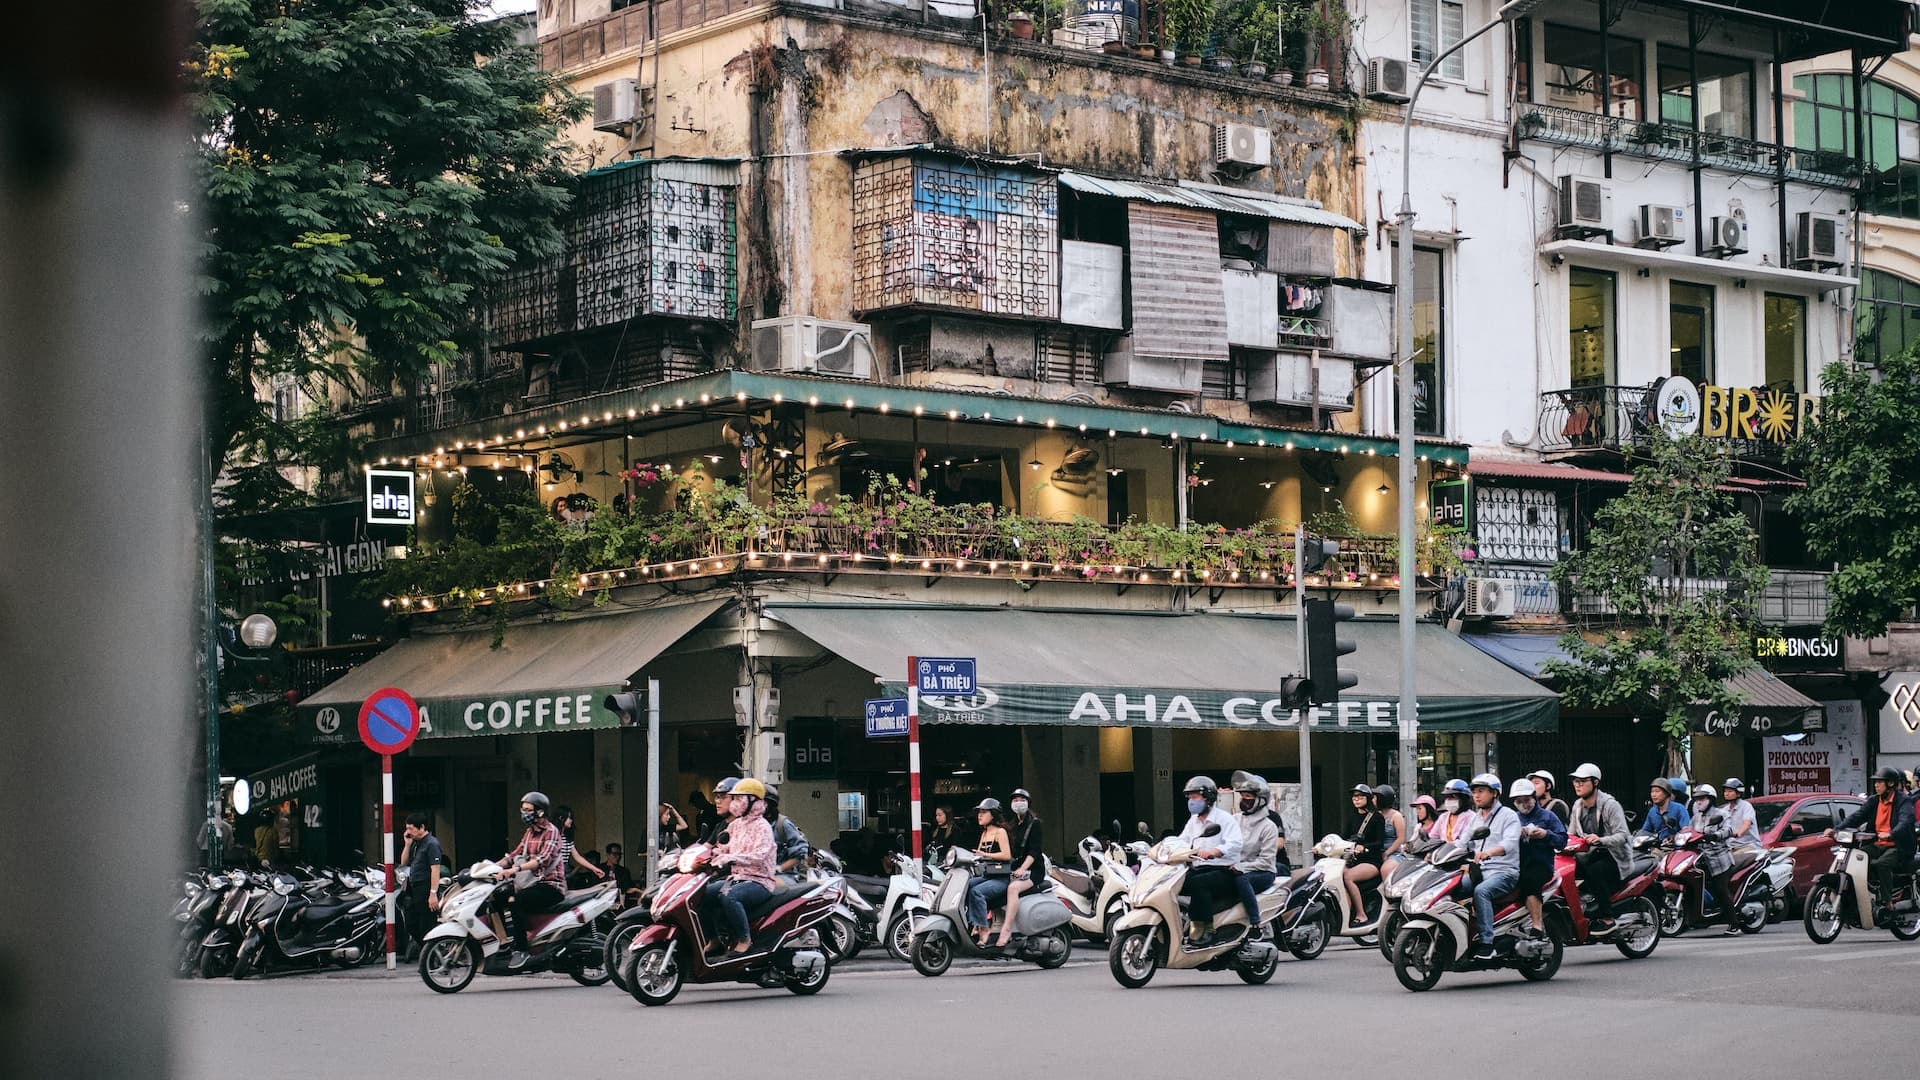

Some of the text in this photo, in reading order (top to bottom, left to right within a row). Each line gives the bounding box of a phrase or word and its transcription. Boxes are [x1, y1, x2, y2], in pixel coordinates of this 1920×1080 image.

[372, 485, 409, 510] aha
[1435, 496, 1464, 520] aha
[938, 662, 955, 672] PHỐ
[923, 674, 970, 691] BÀ TRIỆU
[321, 709, 335, 730] 42
[464, 695, 592, 731] COFFEE
[880, 703, 894, 713] PHỐ
[1069, 692, 1202, 723] AHA
[1750, 716, 1771, 731] 40
[796, 738, 832, 763] aha
[1768, 751, 1829, 766] PHOTOCOPY
[270, 775, 288, 800] AHA
[288, 764, 317, 793] COFFEE
[304, 804, 321, 828] 42
